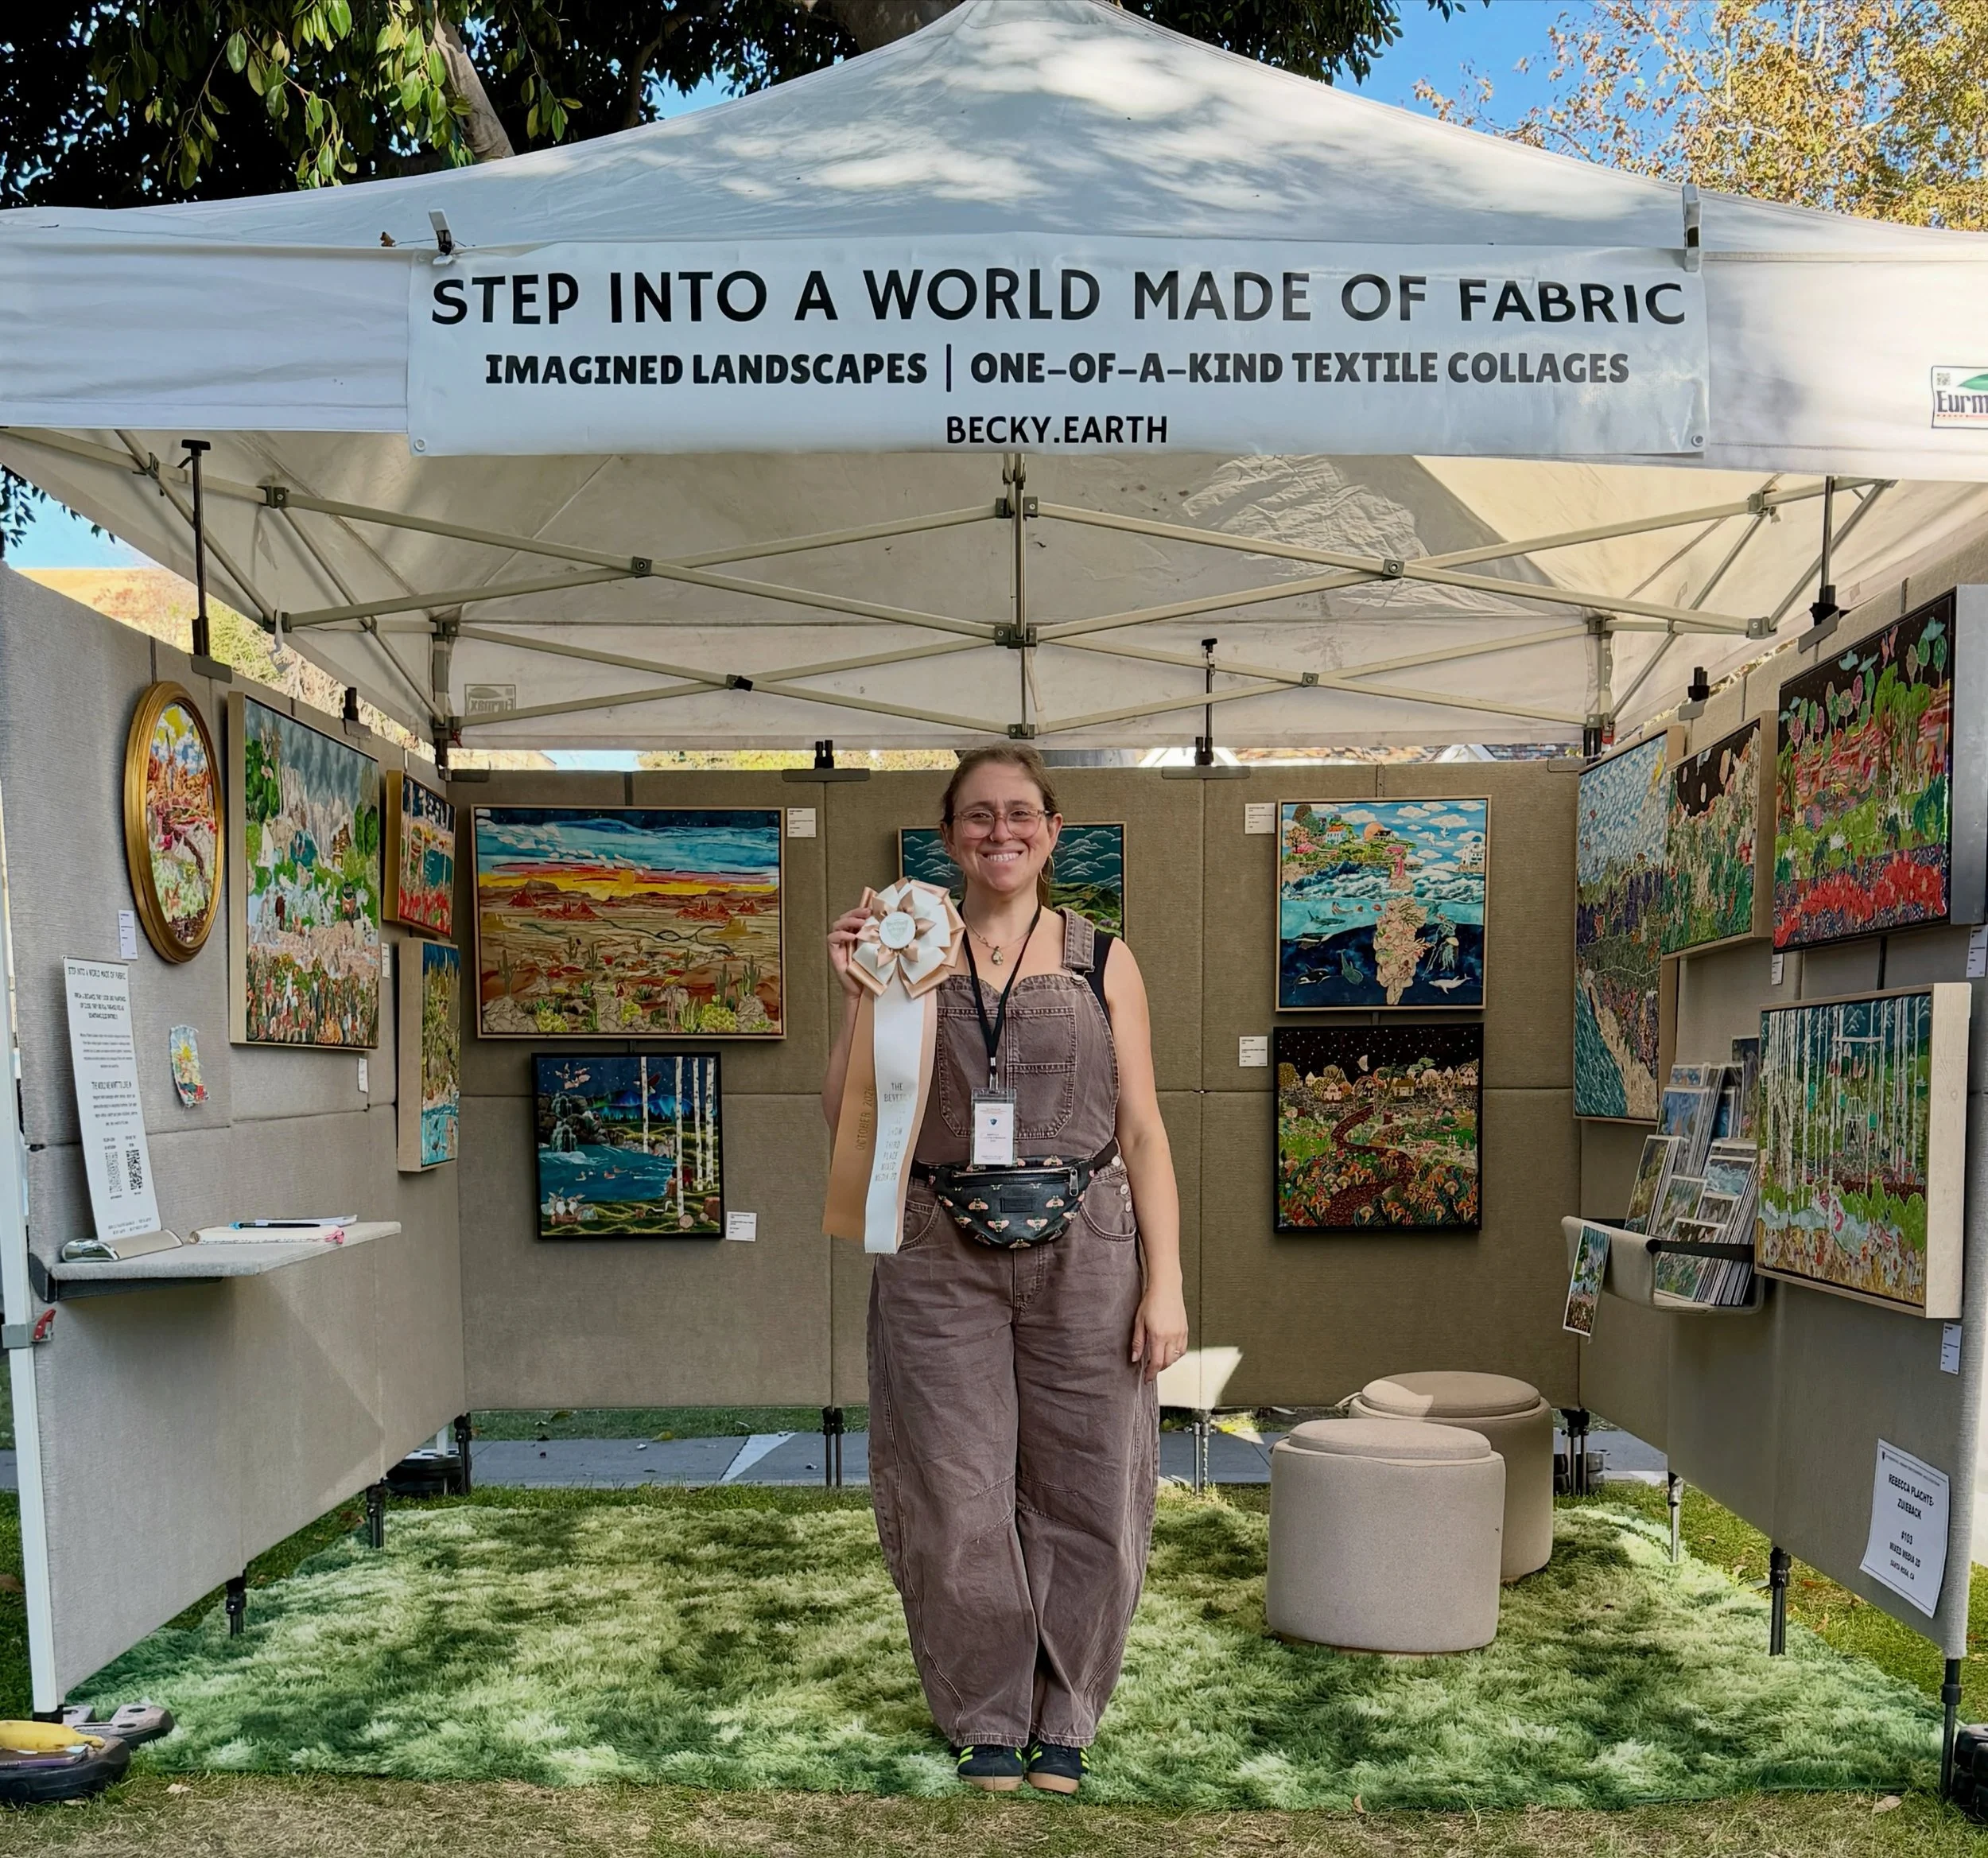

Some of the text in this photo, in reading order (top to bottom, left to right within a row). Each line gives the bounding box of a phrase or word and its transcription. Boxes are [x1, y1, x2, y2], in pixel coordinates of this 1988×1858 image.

[431, 268, 1685, 325] STEP INTO A WORLD MADE OF FABRIC
[485, 354, 683, 385] IMAGINED
[693, 352, 927, 385] LANDSCAPES
[1291, 352, 1438, 383] TEXTILE
[1447, 352, 1629, 383] COLLAGES
[946, 415, 1167, 445] BECKY.EARTH
[856, 1113, 871, 1150] OCTOBER
[1889, 1473, 1910, 1494] REBECCA
